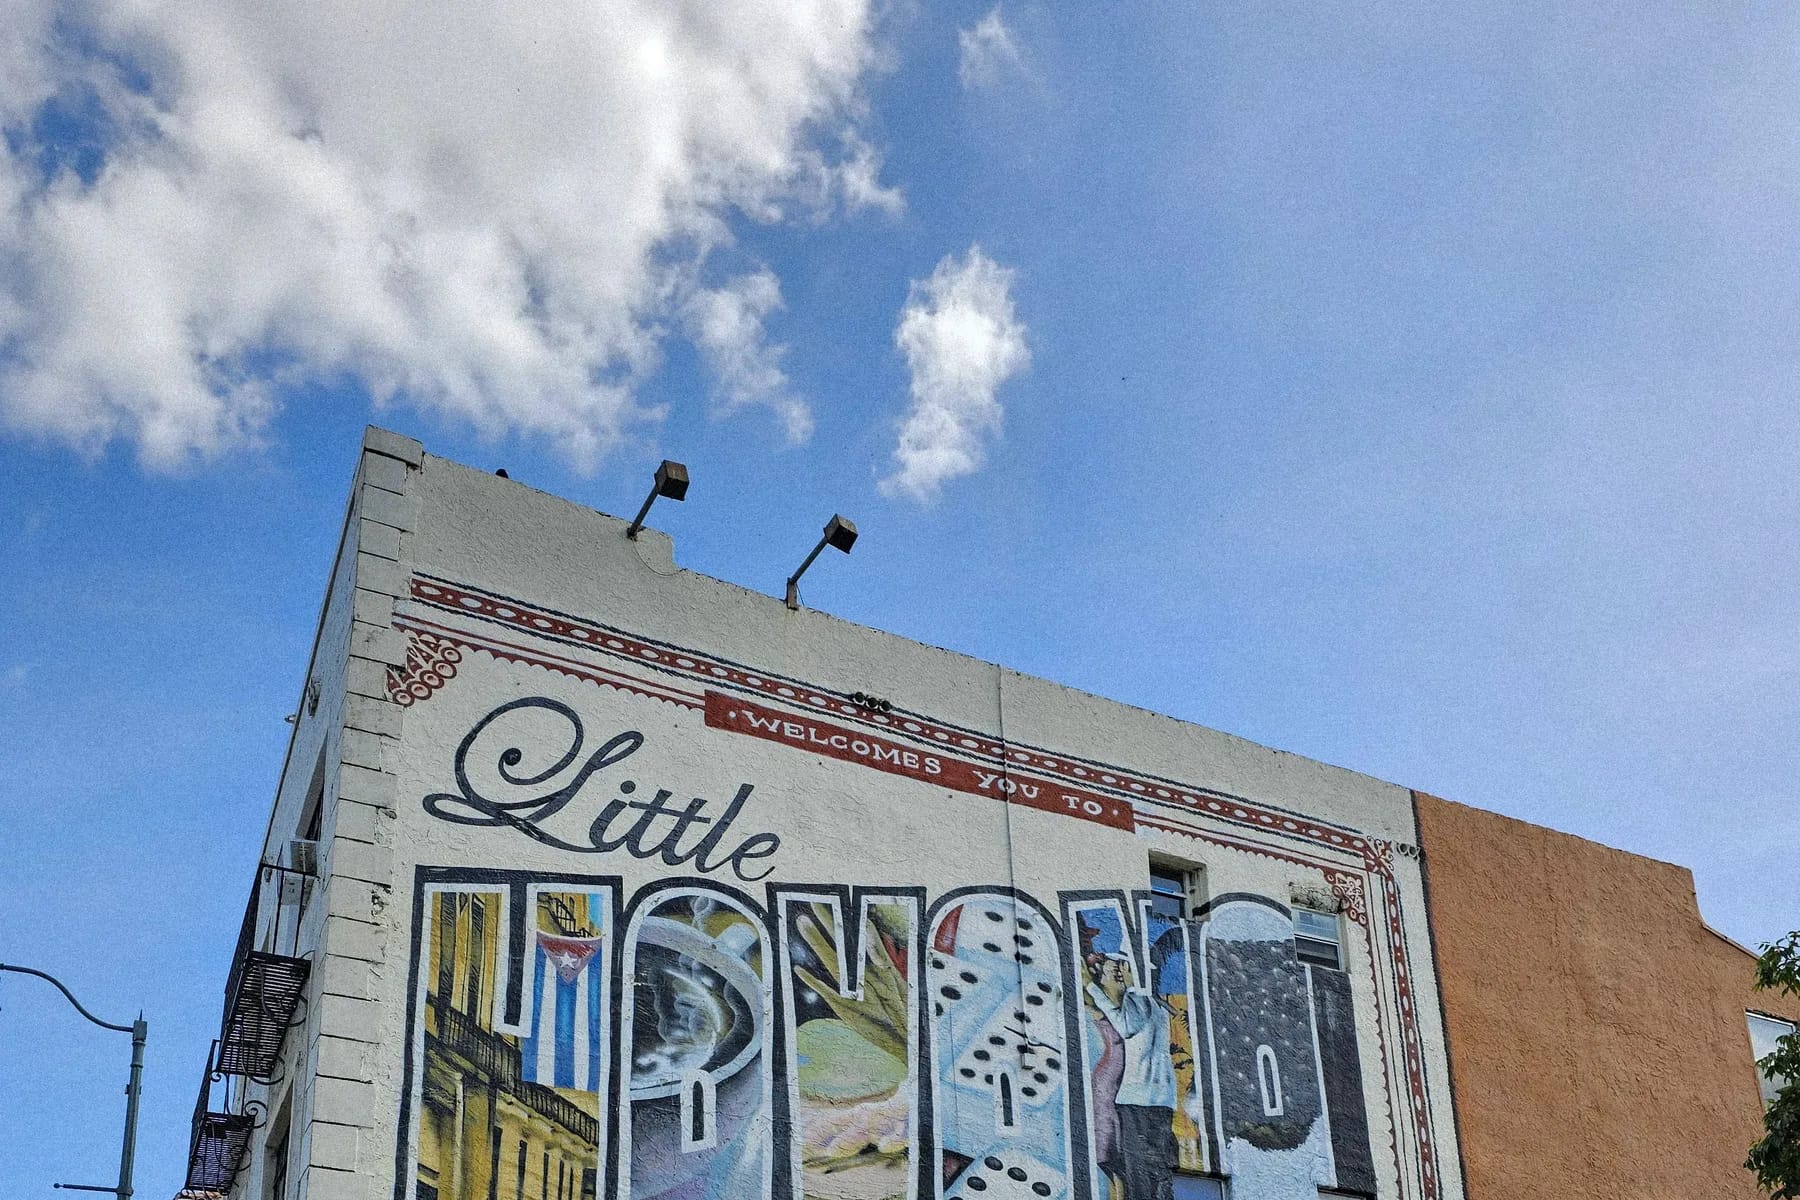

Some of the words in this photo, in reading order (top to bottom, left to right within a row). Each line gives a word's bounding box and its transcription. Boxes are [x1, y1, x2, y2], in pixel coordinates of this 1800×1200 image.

[422, 696, 781, 881] Little
[743, 711, 942, 774] WELCOMES
[972, 769, 1039, 800] YOU
[1062, 794, 1103, 816] TO
